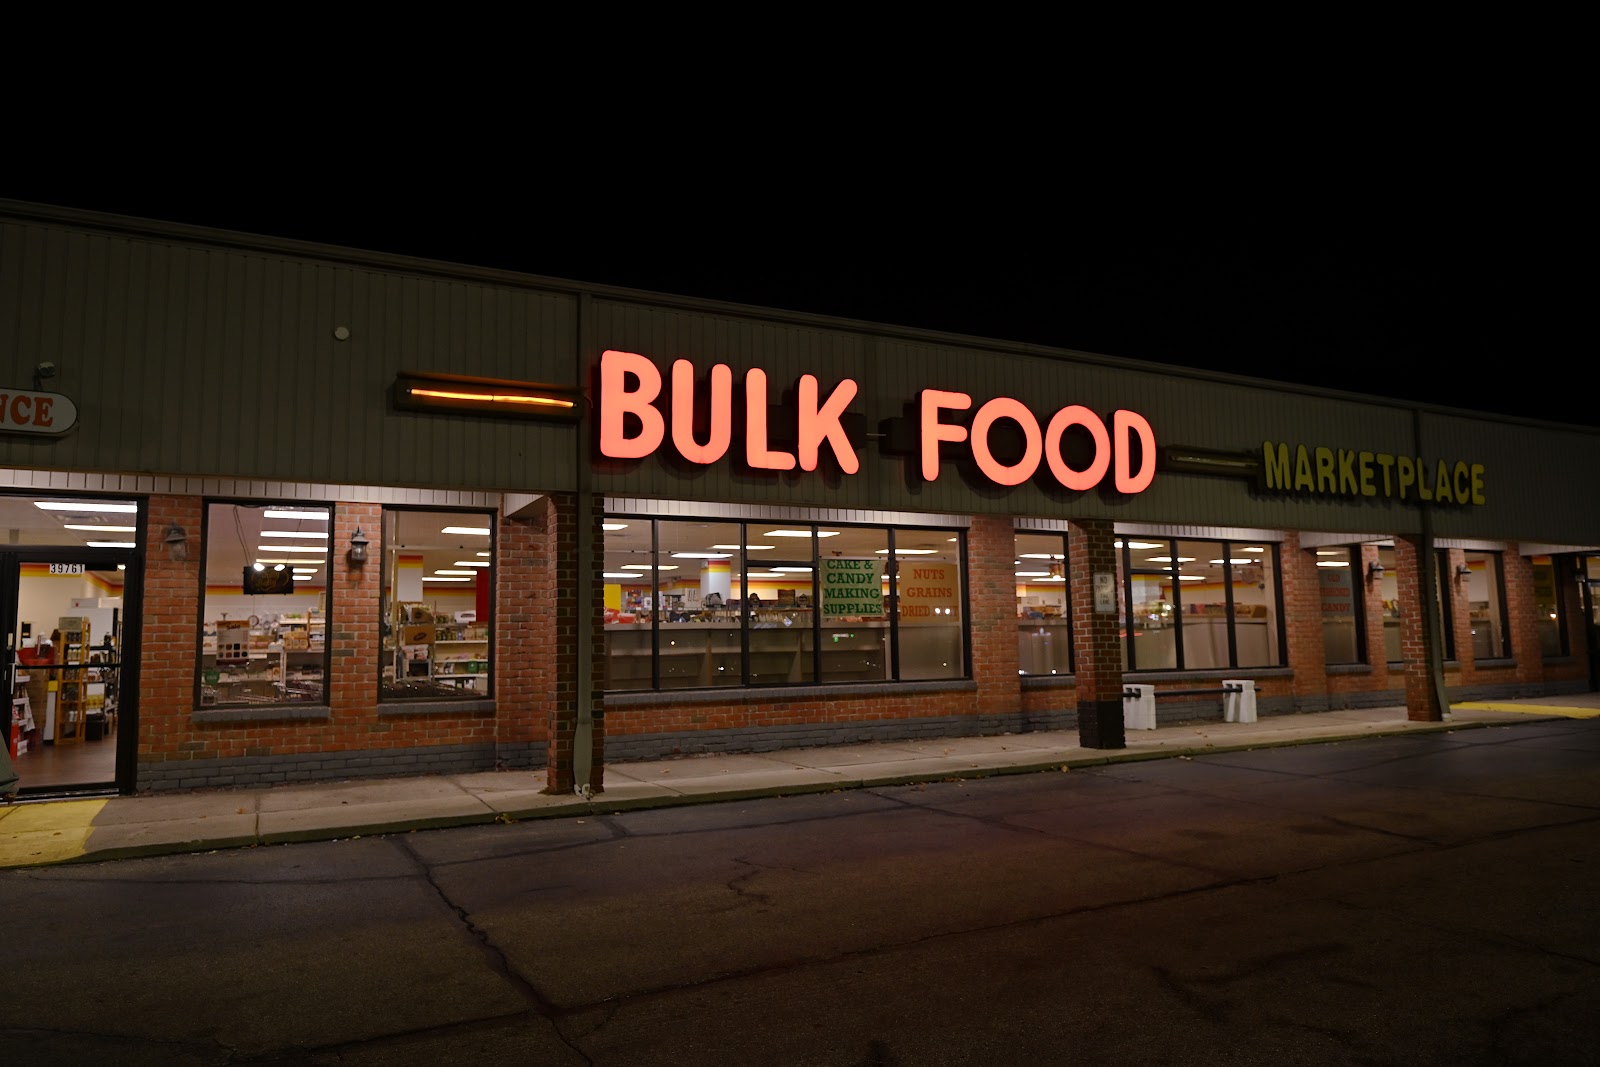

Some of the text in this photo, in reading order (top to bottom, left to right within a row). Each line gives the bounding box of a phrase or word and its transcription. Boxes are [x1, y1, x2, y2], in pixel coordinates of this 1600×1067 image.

[600, 350, 1487, 505] BULK FOOD MARKETPLACE
[51, 563, 83, 574] 39761
[827, 560, 873, 570] CAKE &
[827, 573, 874, 584] CANDY
[913, 569, 945, 580] NUTS
[824, 588, 880, 599] MAKING
[906, 587, 952, 598] GRAINS
[823, 603, 883, 614] SUPPLIES
[902, 605, 931, 617] DRIED
